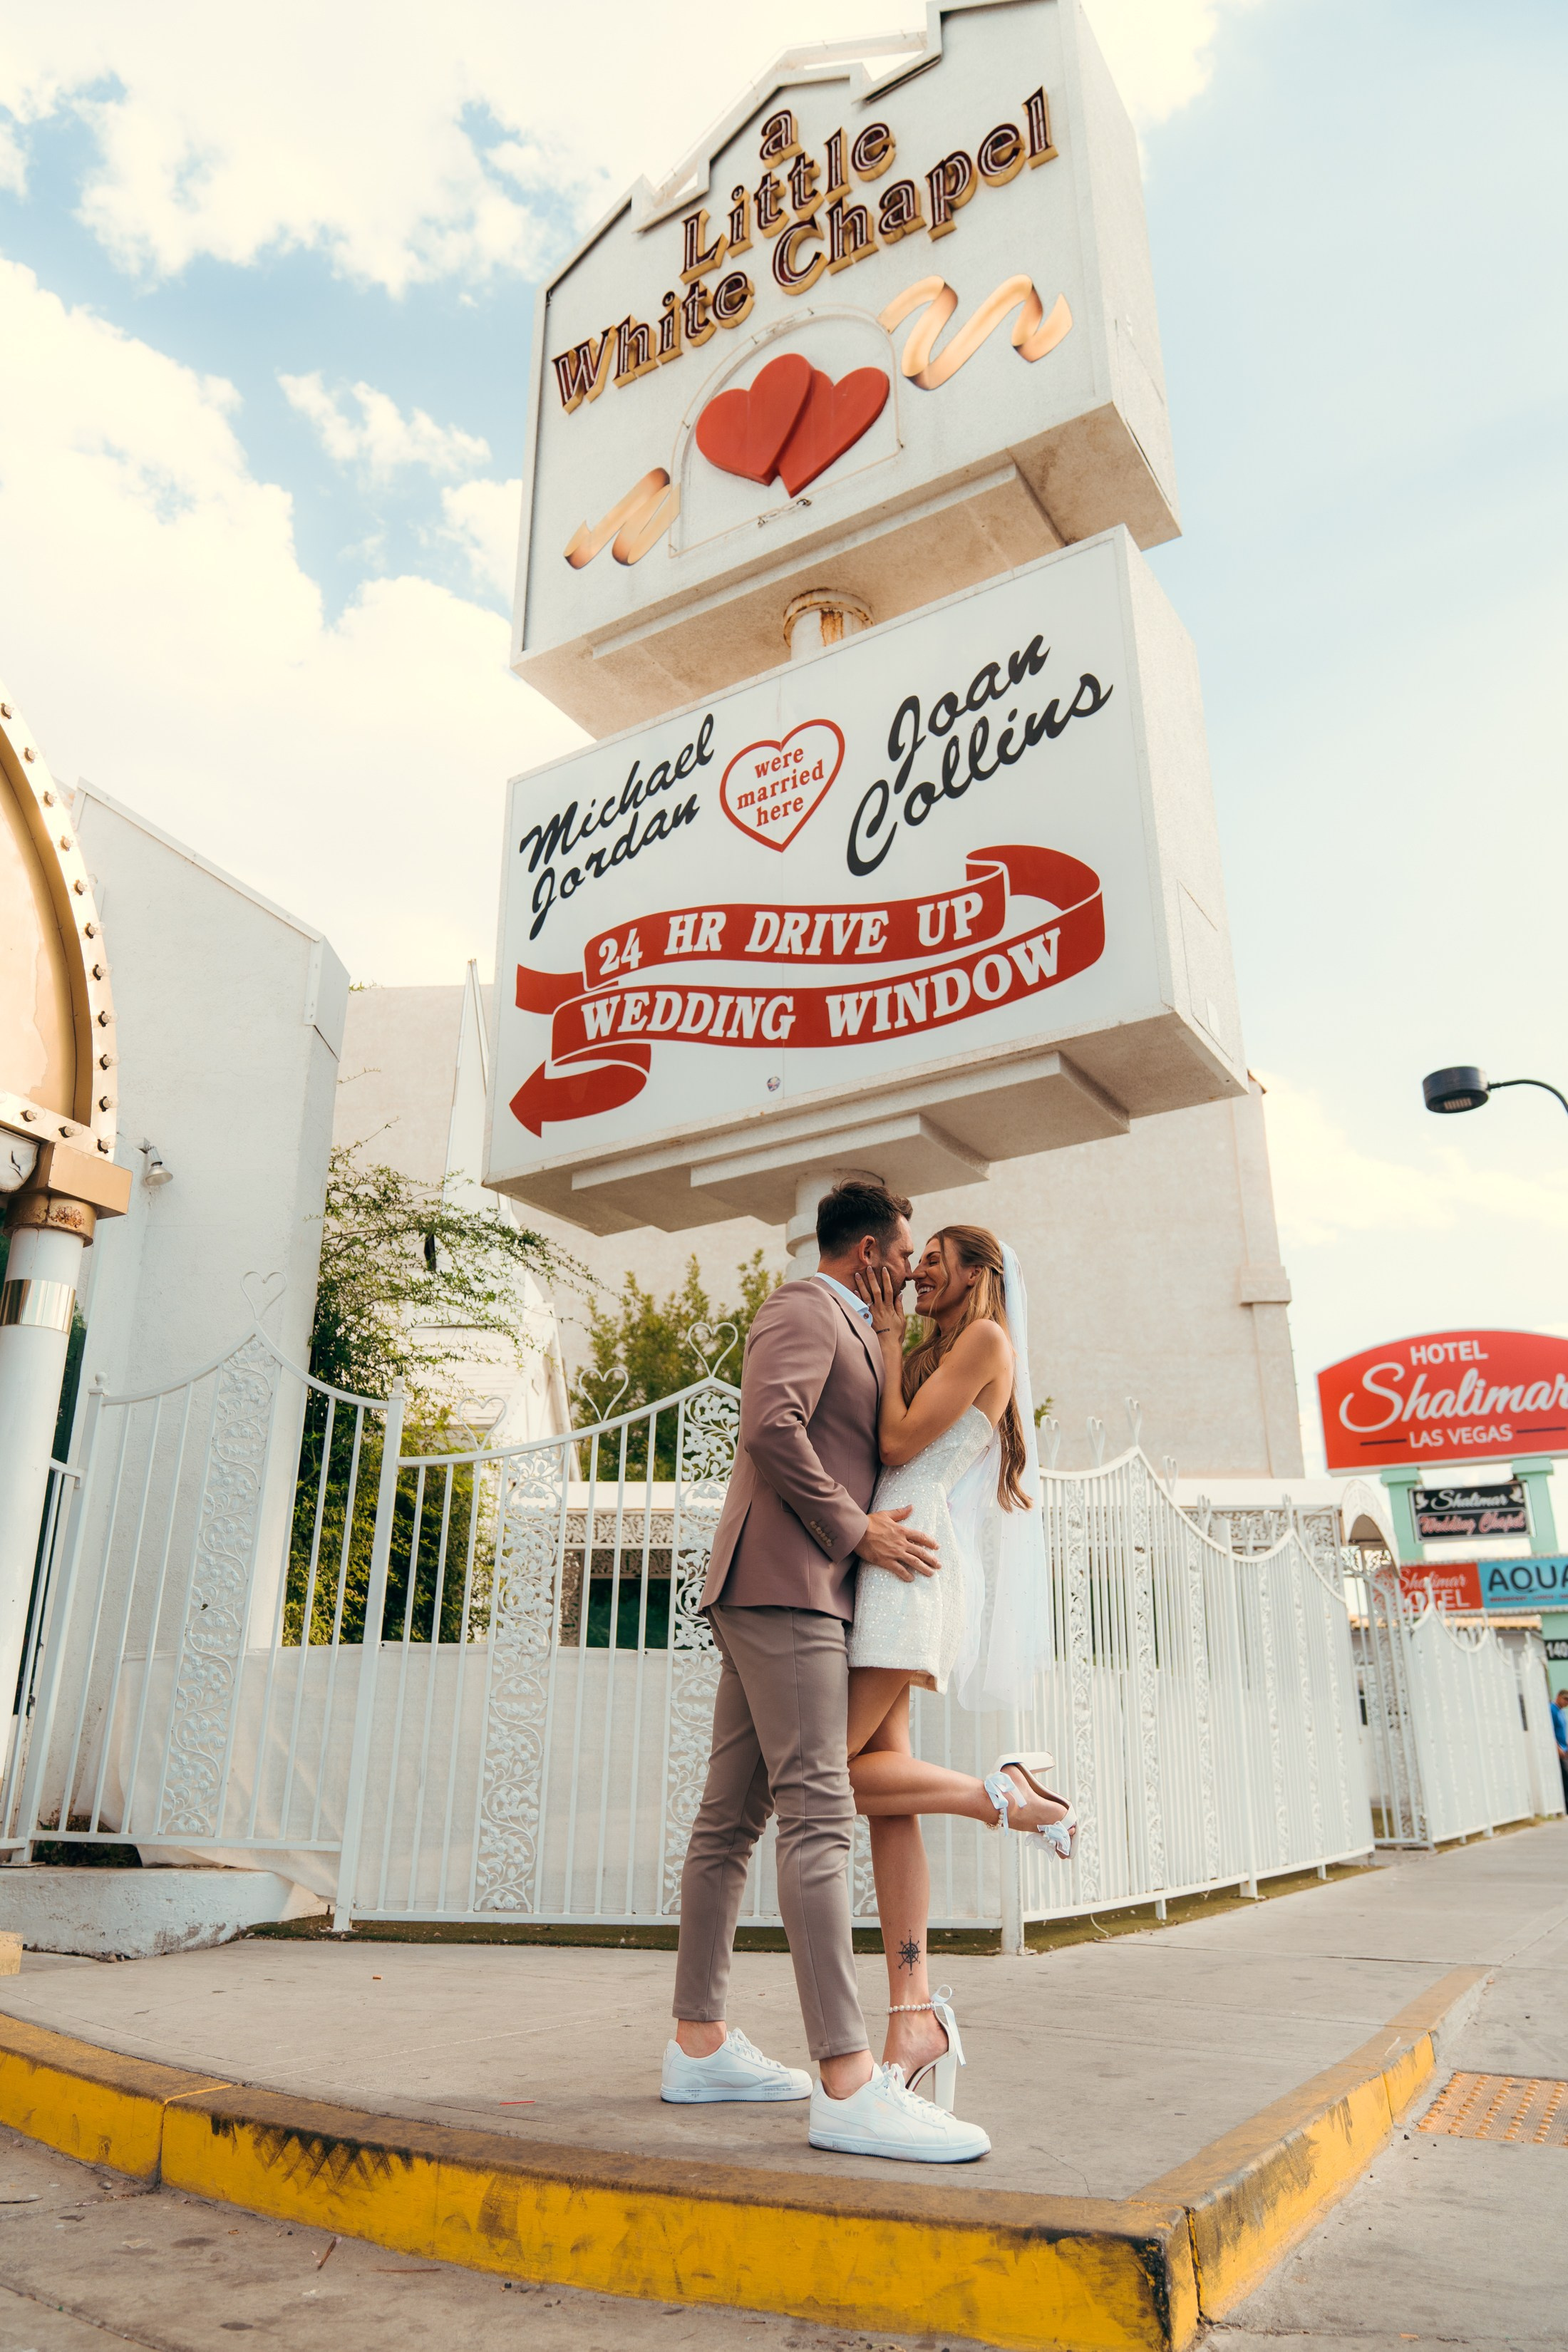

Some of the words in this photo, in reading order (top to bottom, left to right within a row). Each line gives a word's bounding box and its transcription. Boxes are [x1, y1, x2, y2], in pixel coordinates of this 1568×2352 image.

[759, 109, 801, 167] a
[680, 122, 897, 283] Little
[551, 270, 755, 413] White
[772, 85, 1058, 294] Chapel
[887, 634, 1051, 795] Joan
[520, 713, 714, 873] Michael
[737, 759, 825, 810] married
[754, 748, 804, 779] were
[846, 673, 1114, 877] Collins
[756, 793, 804, 827] here
[529, 793, 701, 941] Jordan
[598, 928, 643, 976] 24
[664, 912, 727, 956] HR
[745, 910, 889, 956] DRIVE
[917, 892, 984, 947] UP
[581, 991, 796, 1041] WEDDING
[825, 927, 1061, 1038] WINDOW
[1410, 1340, 1488, 1366] HOTEL
[1339, 1362, 1568, 1433] Shalimar
[1409, 1428, 1444, 1448] LAS
[1447, 1423, 1513, 1445] VEGAS
[1420, 1515, 1477, 1536] Wedding
[1479, 1510, 1525, 1533] Chapel
[1430, 1490, 1509, 1510] Shalimar
[1400, 1589, 1472, 1612] OTEL
